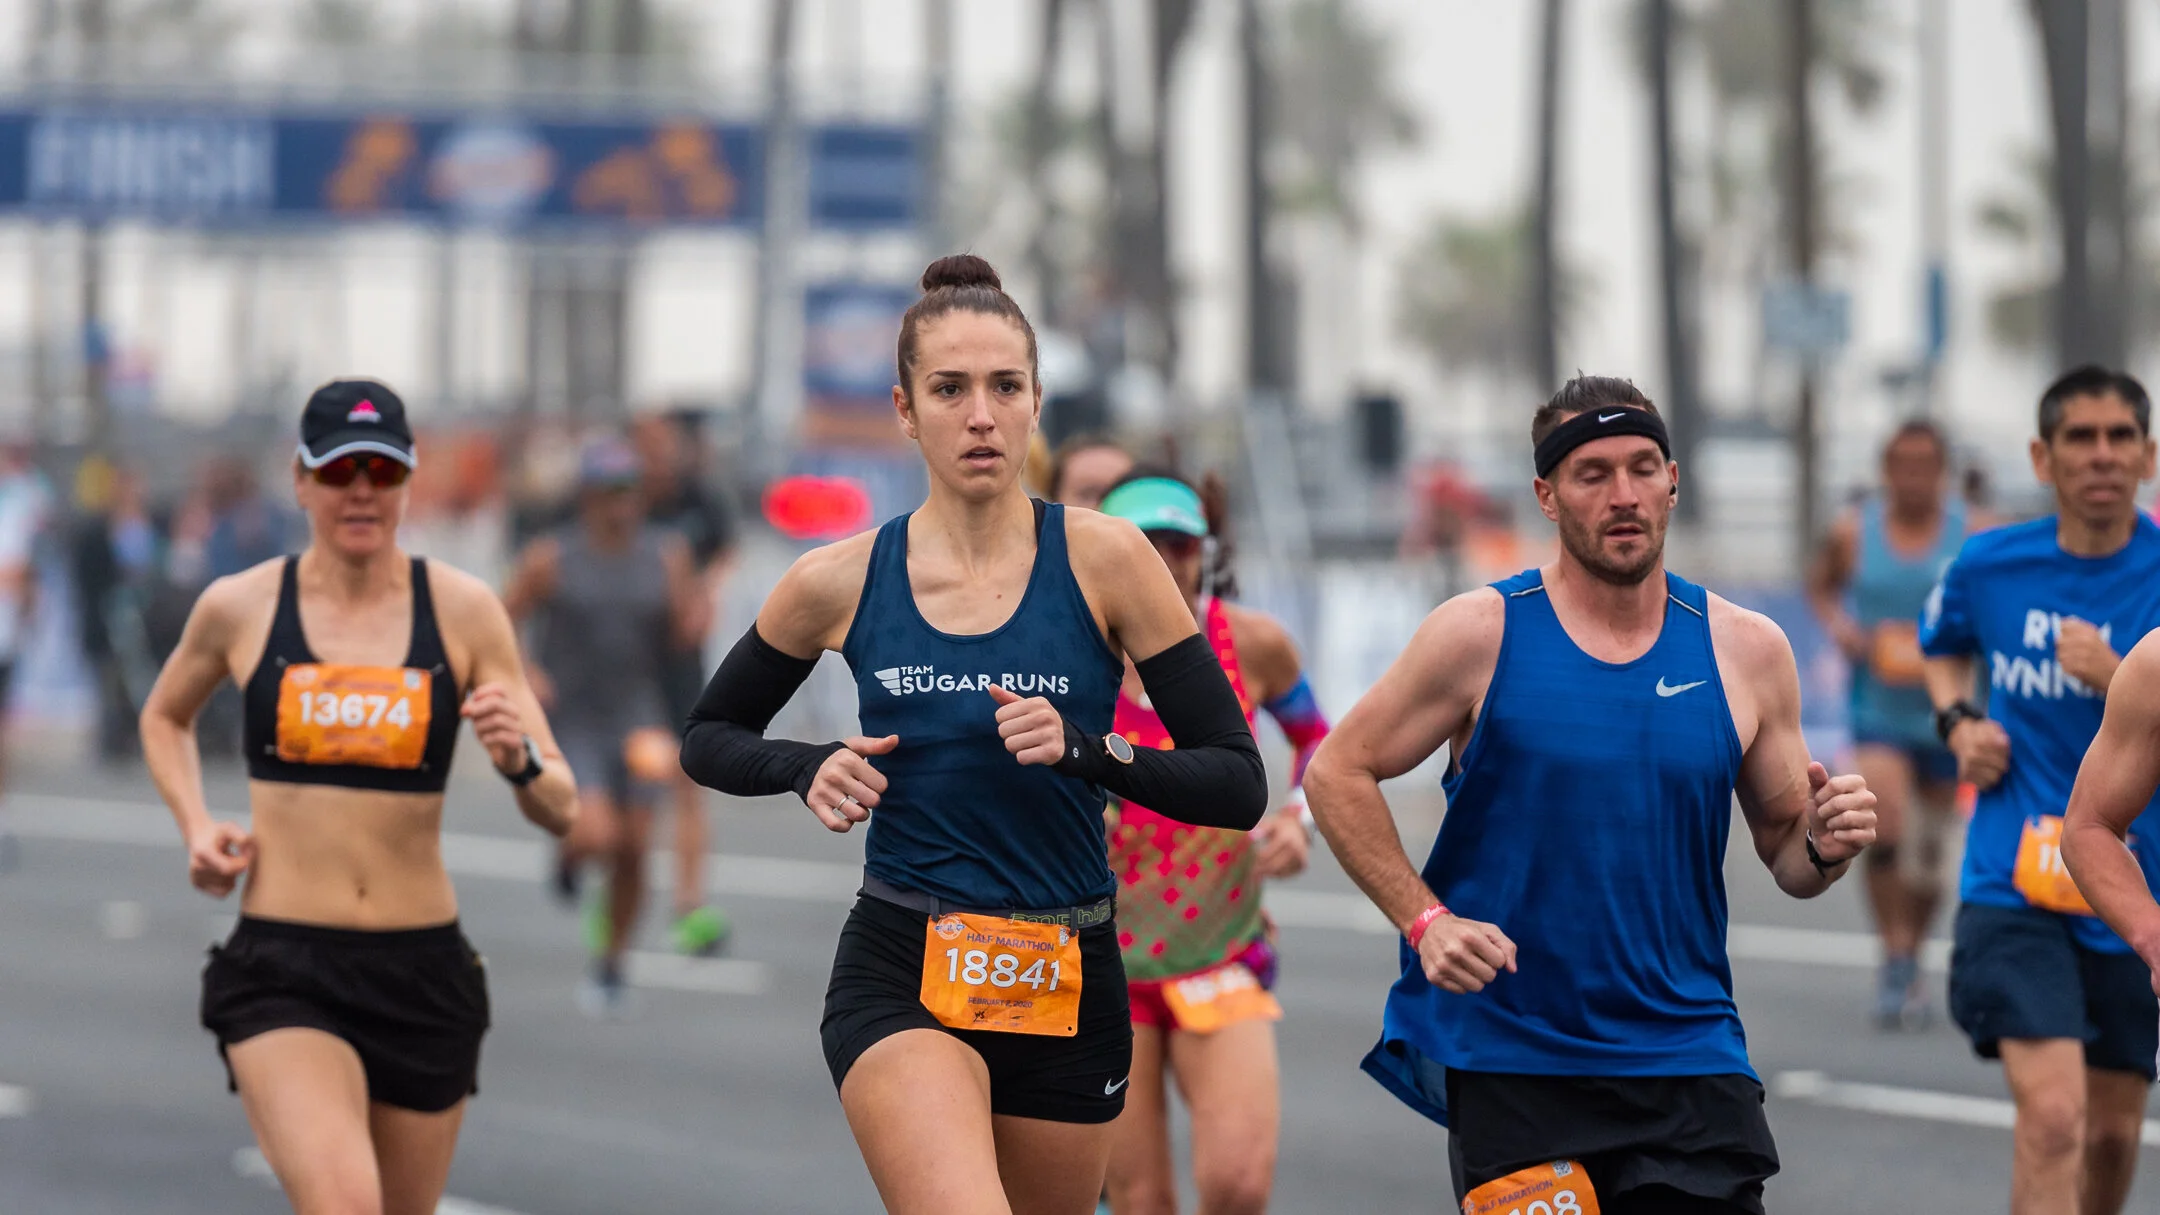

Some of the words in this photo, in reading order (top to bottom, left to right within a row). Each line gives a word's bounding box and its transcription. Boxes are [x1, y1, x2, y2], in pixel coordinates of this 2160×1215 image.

[901, 665, 934, 675] TEAM
[902, 674, 991, 695] SUGAR
[1001, 673, 1070, 695] RUNS
[298, 691, 412, 731] 13674
[966, 933, 993, 946] HALF
[995, 936, 1055, 952] MARATHON
[945, 948, 1060, 991] 18841
[1477, 1200, 1496, 1213] HALF
[1498, 1179, 1553, 1206] MARATHON
